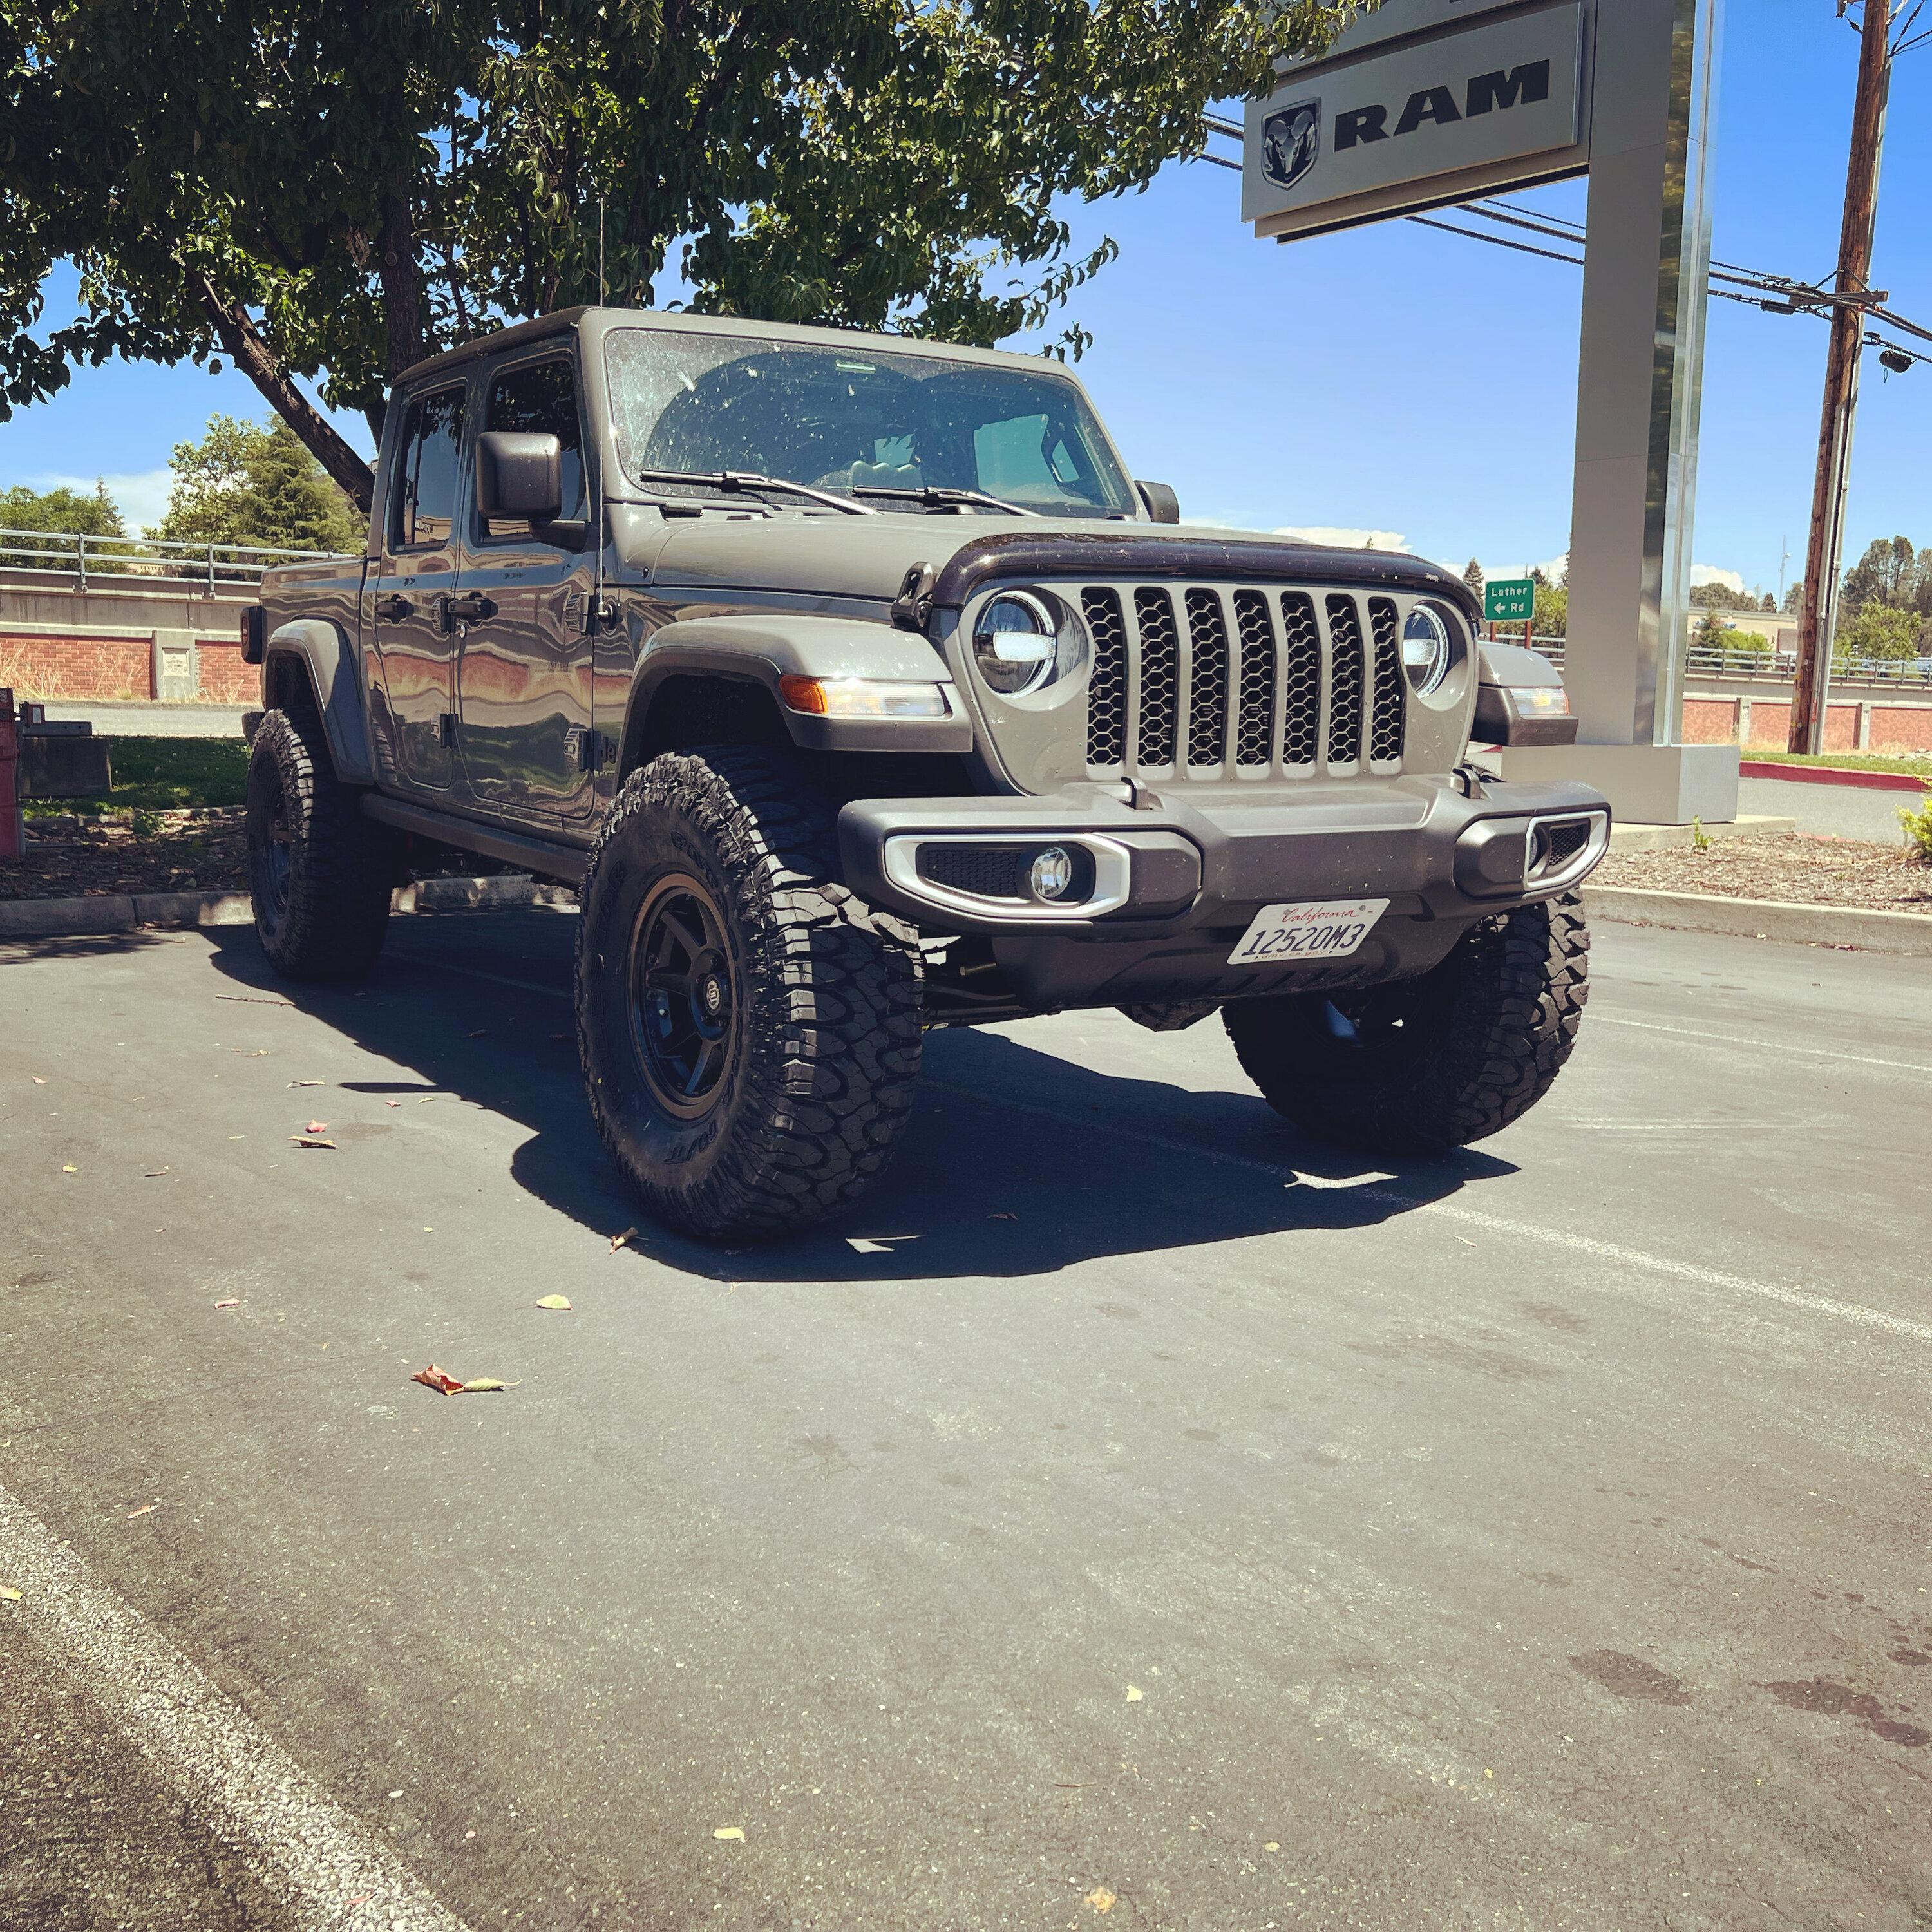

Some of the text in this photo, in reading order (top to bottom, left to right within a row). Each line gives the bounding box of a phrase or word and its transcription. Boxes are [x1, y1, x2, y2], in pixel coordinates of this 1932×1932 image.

[1334, 59, 1550, 152] RAM
[1491, 587, 1528, 597] Luther
[1511, 602, 1524, 612] Rd
[1282, 907, 1359, 925] California
[1242, 923, 1365, 956] 12520M3
